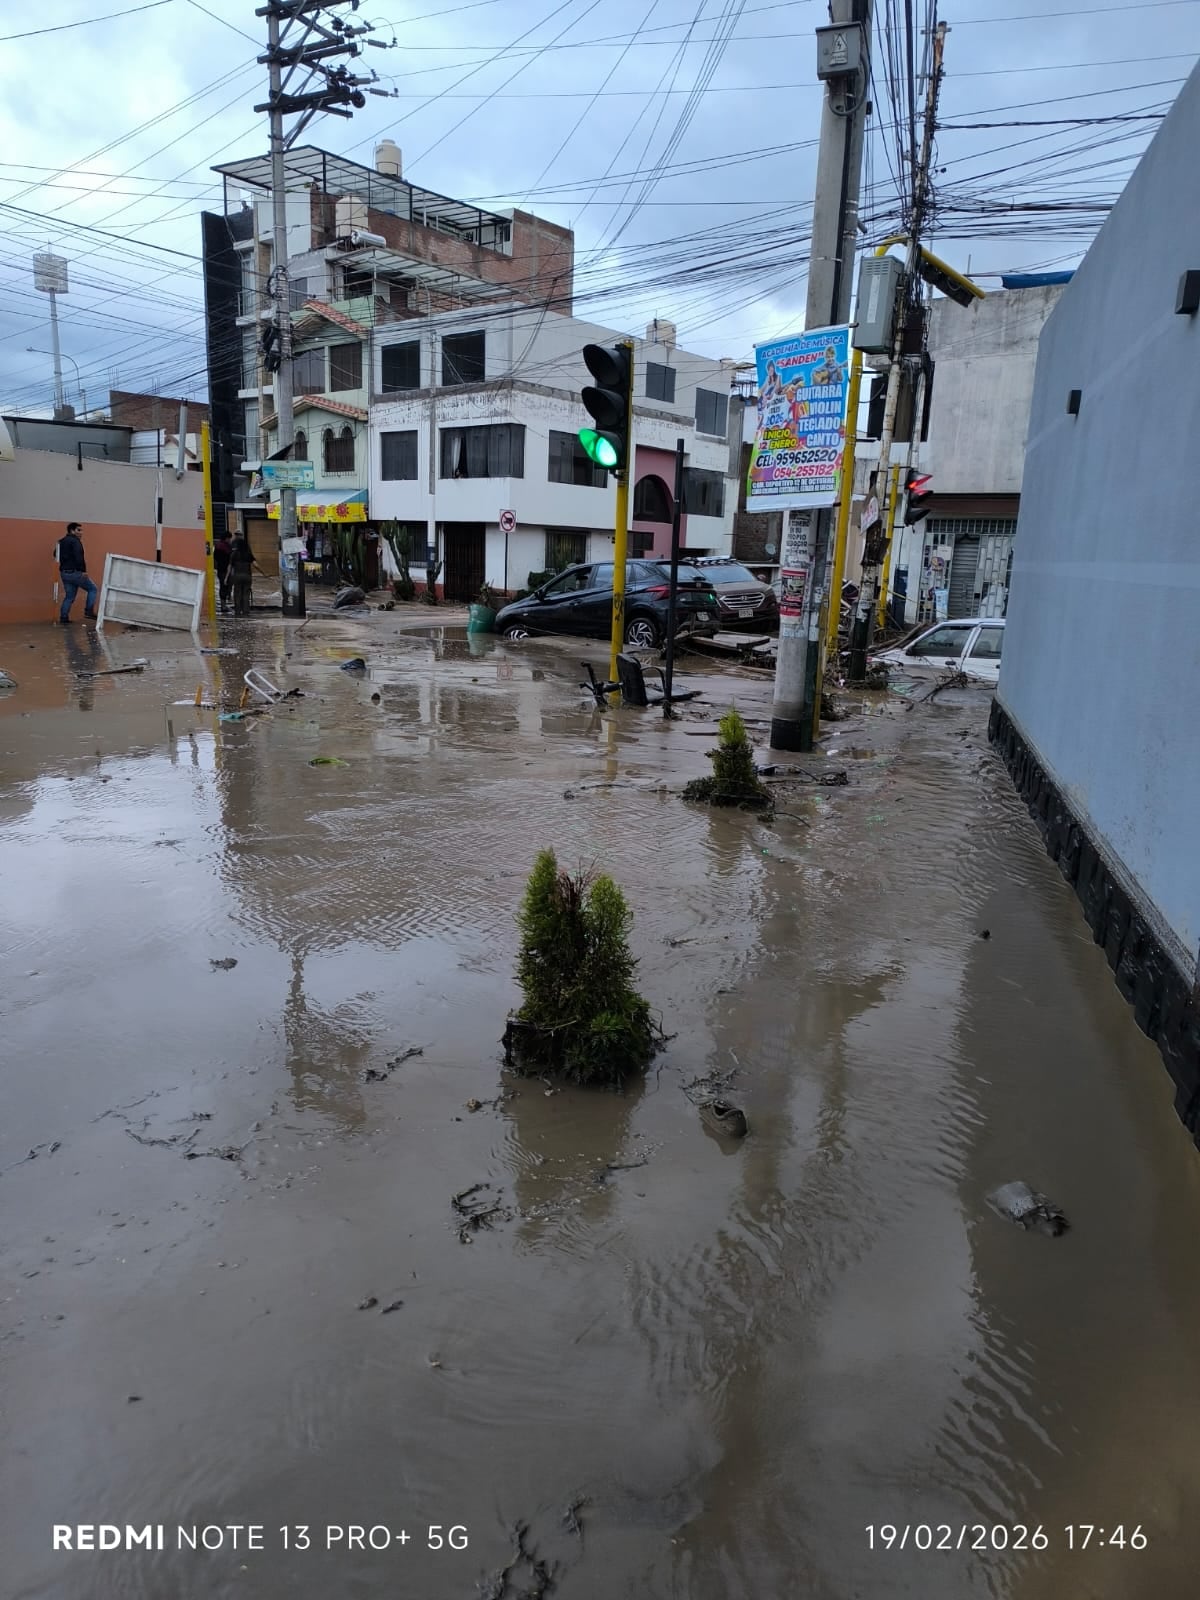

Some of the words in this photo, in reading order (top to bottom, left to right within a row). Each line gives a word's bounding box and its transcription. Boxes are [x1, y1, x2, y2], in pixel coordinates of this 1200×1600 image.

[762, 343, 799, 359] ACADEMIA
[800, 340, 812, 350] DE
[796, 384, 843, 401] GUITARRA
[809, 401, 842, 415] VIOLIN
[798, 417, 841, 432] TECLADO
[763, 428, 790, 440] INICIO
[806, 433, 839, 447] CANTO
[770, 439, 797, 449] ENERO
[776, 449, 838, 466] 959652520
[773, 464, 835, 479] 054-255182
